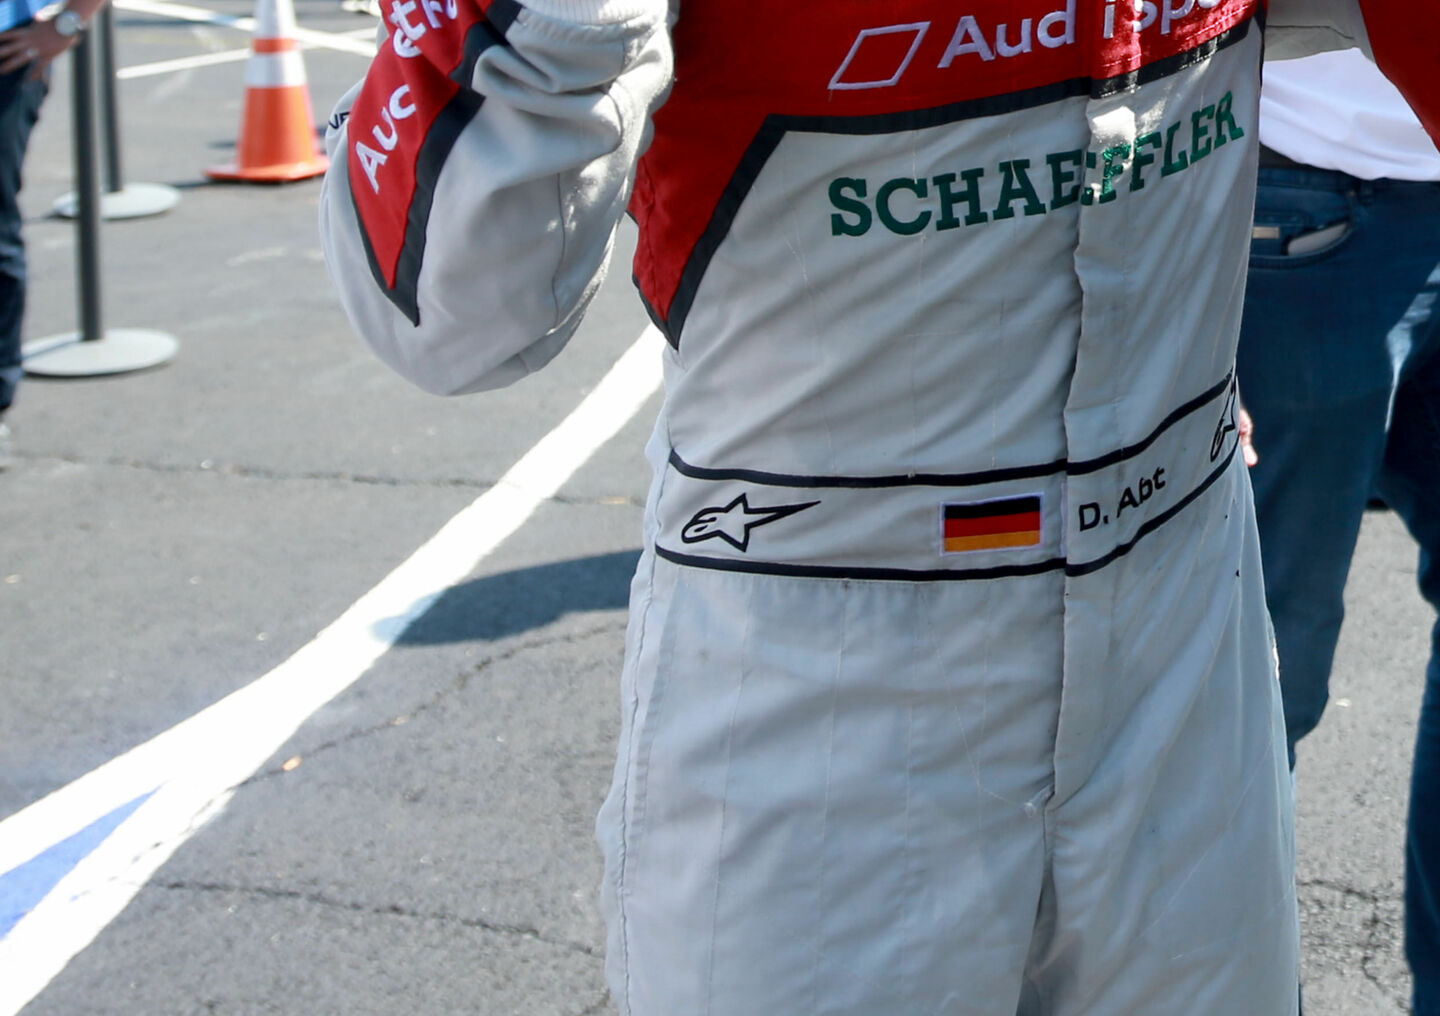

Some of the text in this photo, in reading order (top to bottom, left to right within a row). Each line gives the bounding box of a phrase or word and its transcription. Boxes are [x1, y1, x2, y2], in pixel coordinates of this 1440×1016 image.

[828, 90, 1245, 237] SCHAEFFLER
[1078, 466, 1167, 533] D. Abt
